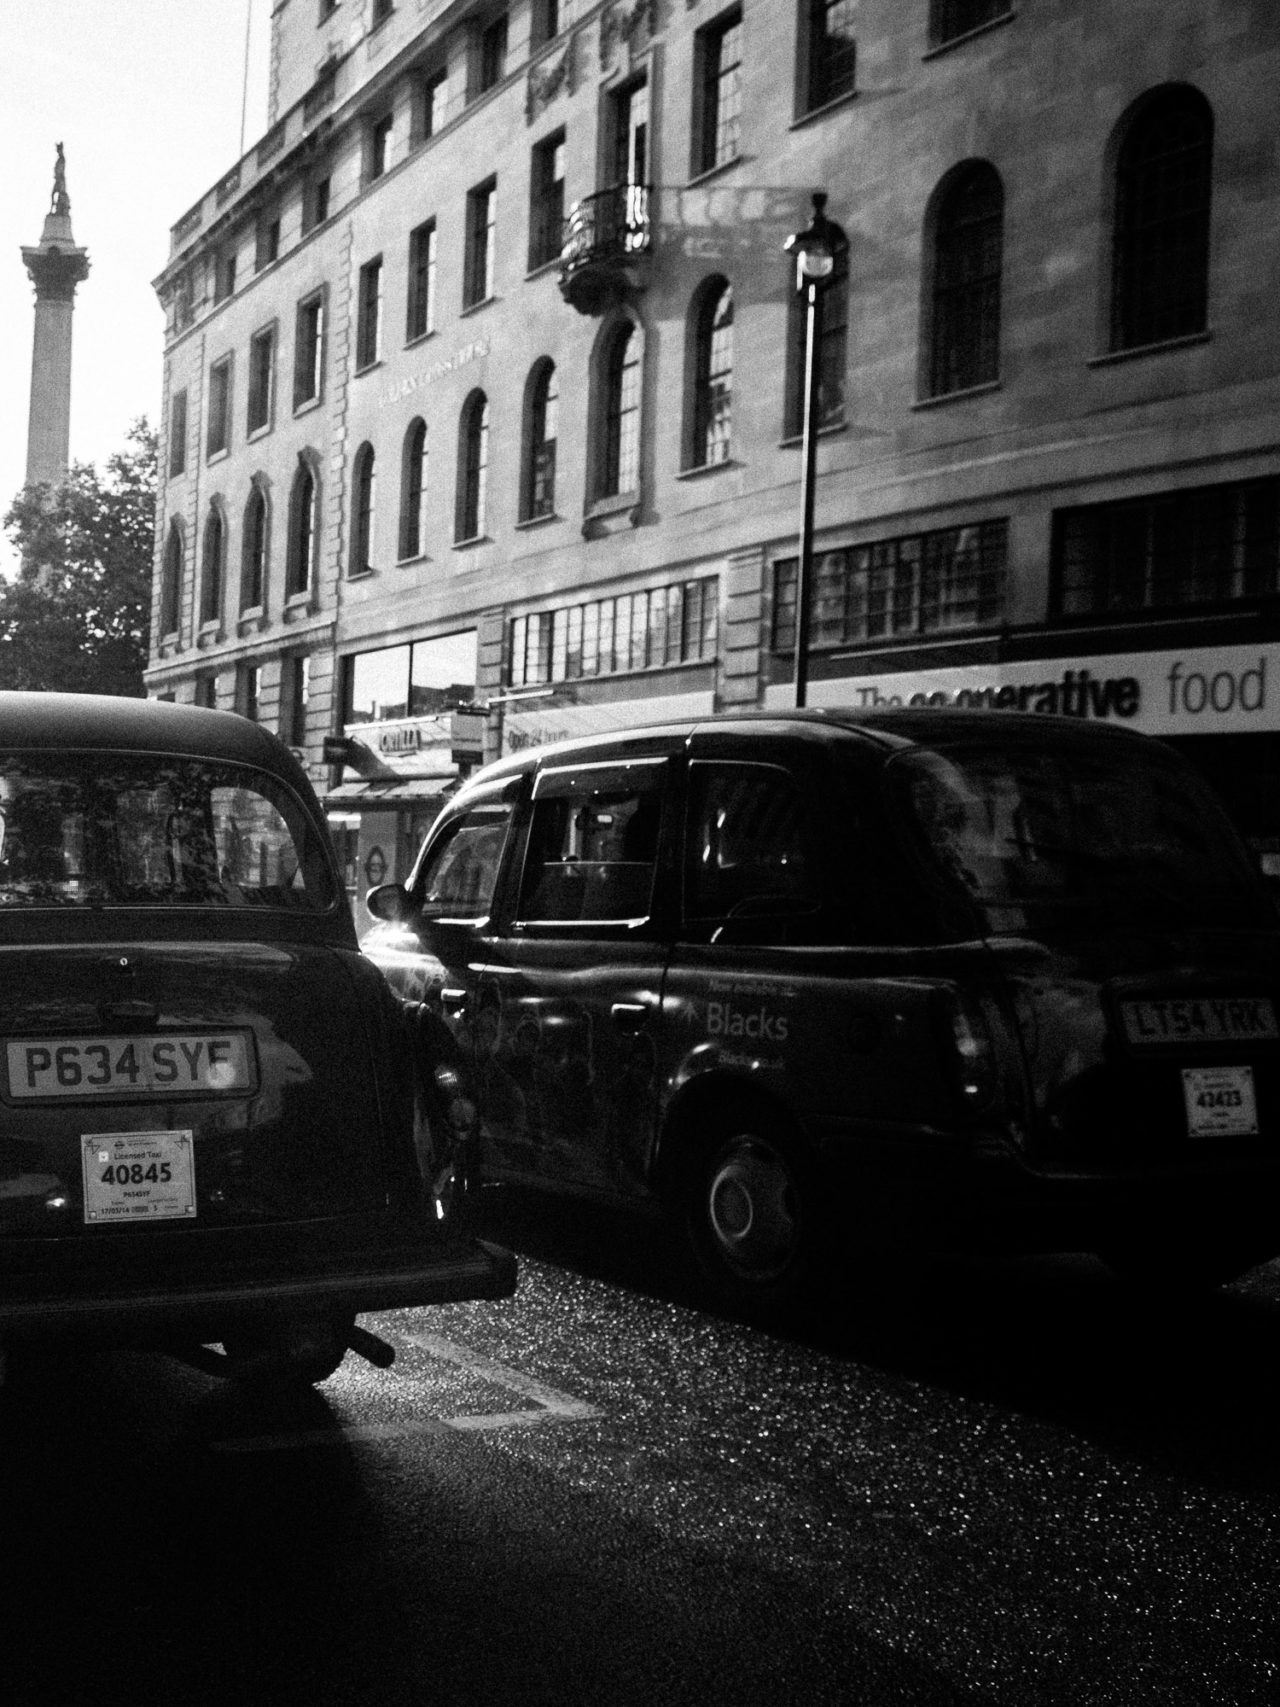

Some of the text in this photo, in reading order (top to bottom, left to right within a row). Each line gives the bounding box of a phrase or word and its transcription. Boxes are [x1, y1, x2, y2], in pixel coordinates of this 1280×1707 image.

[1166, 656, 1269, 714] food
[707, 1002, 789, 1040] Blacks
[1133, 1000, 1266, 1035] LT54 YRK
[25, 1040, 232, 1088] P634 SYF
[101, 1162, 171, 1185] 40845
[114, 1152, 146, 1160] Licensed
